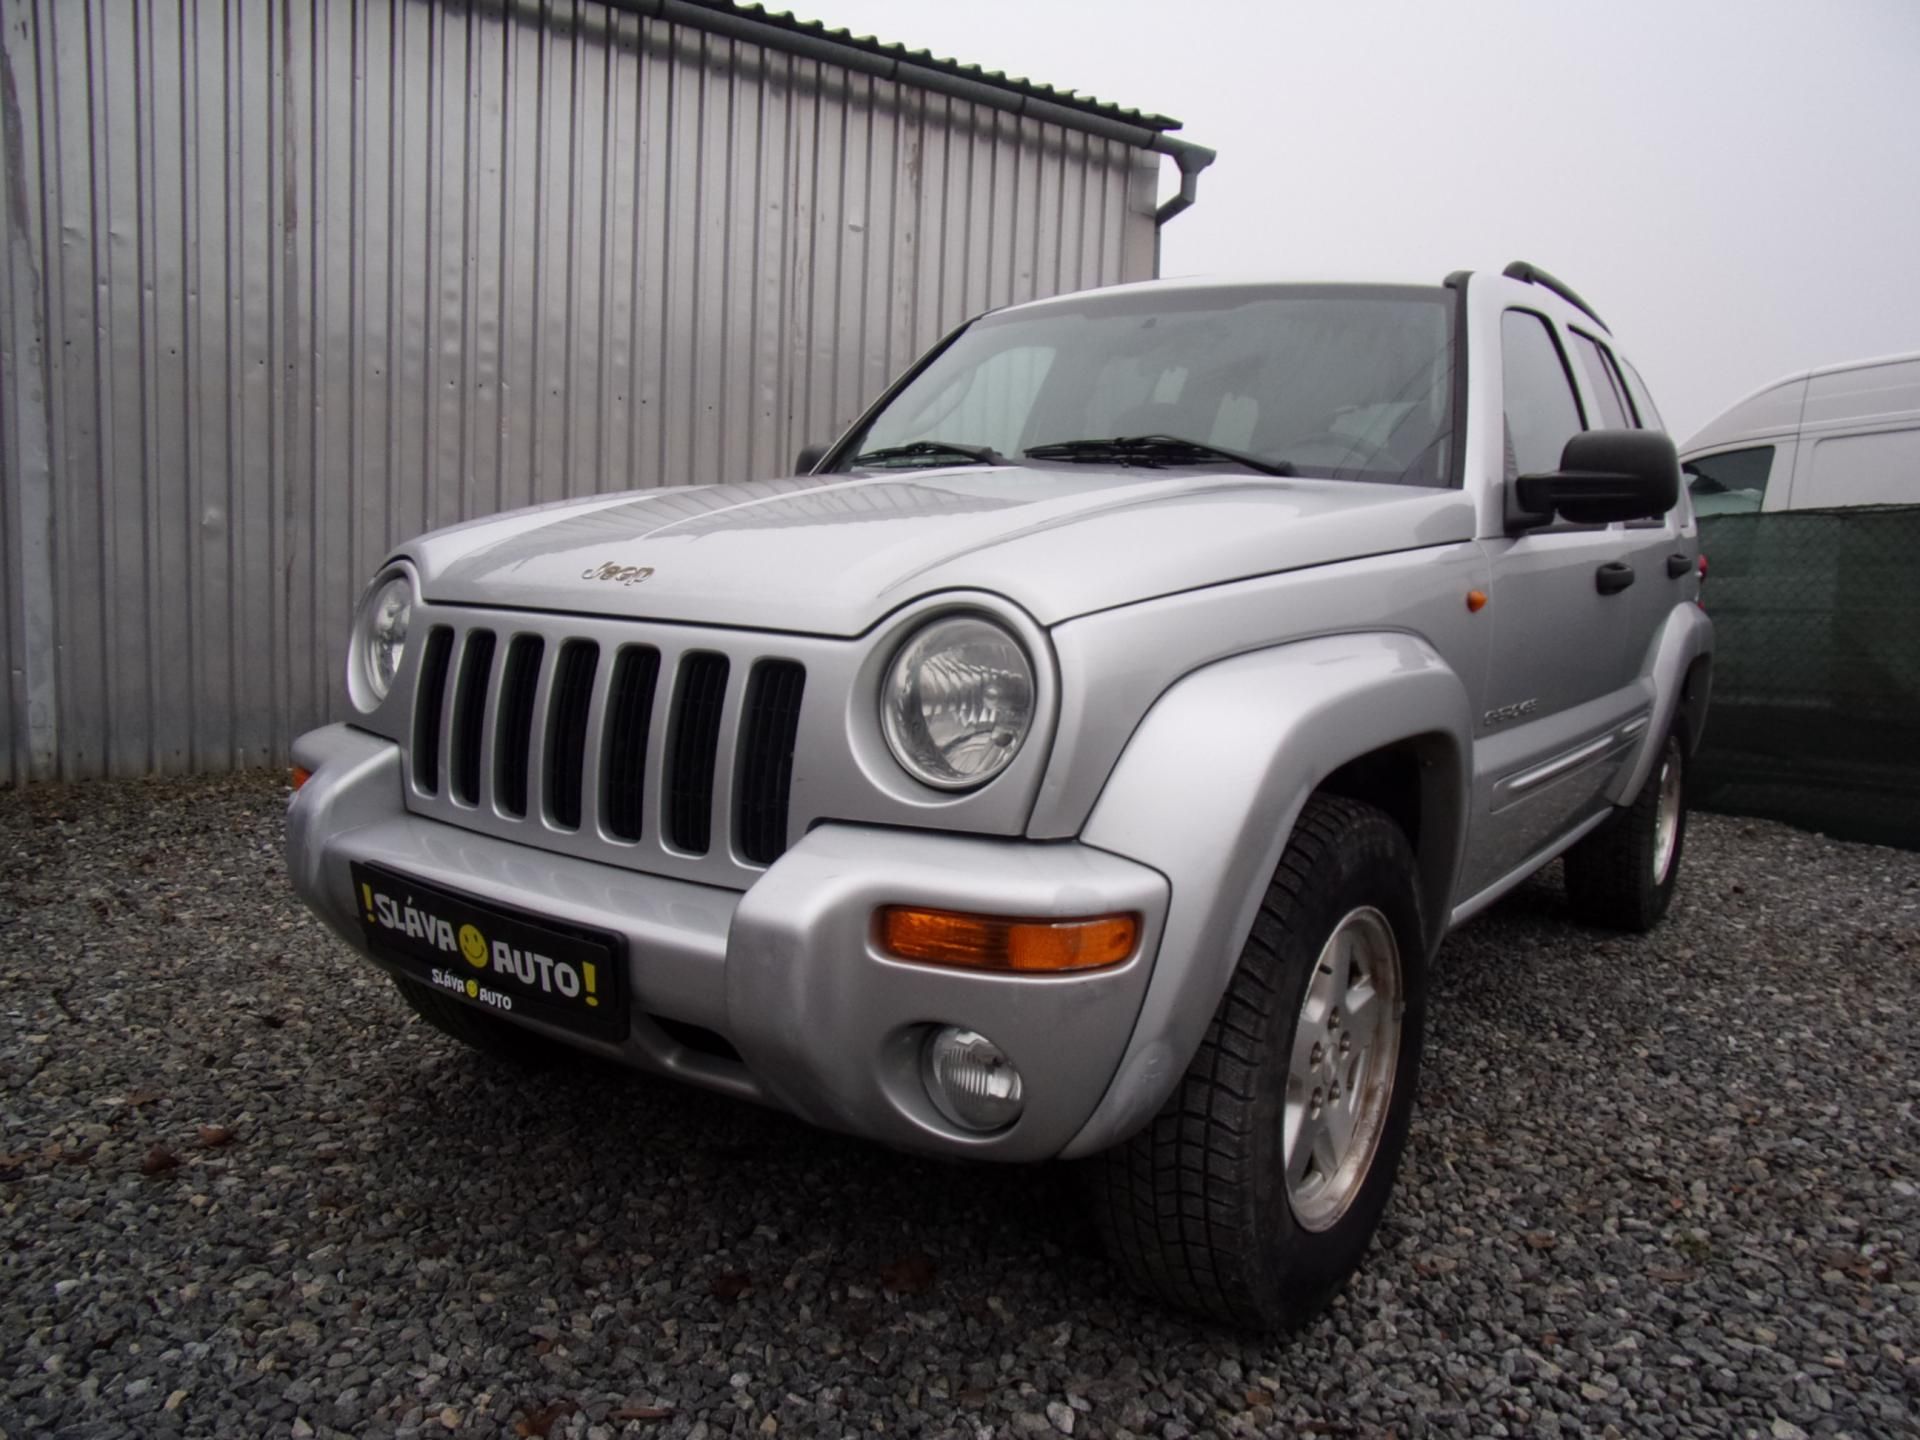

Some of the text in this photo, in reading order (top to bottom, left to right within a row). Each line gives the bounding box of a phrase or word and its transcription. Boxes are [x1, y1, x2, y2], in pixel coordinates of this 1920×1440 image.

[431, 968, 512, 1010] SLÁVA AUTO
[492, 940, 598, 1006] AUTO!
